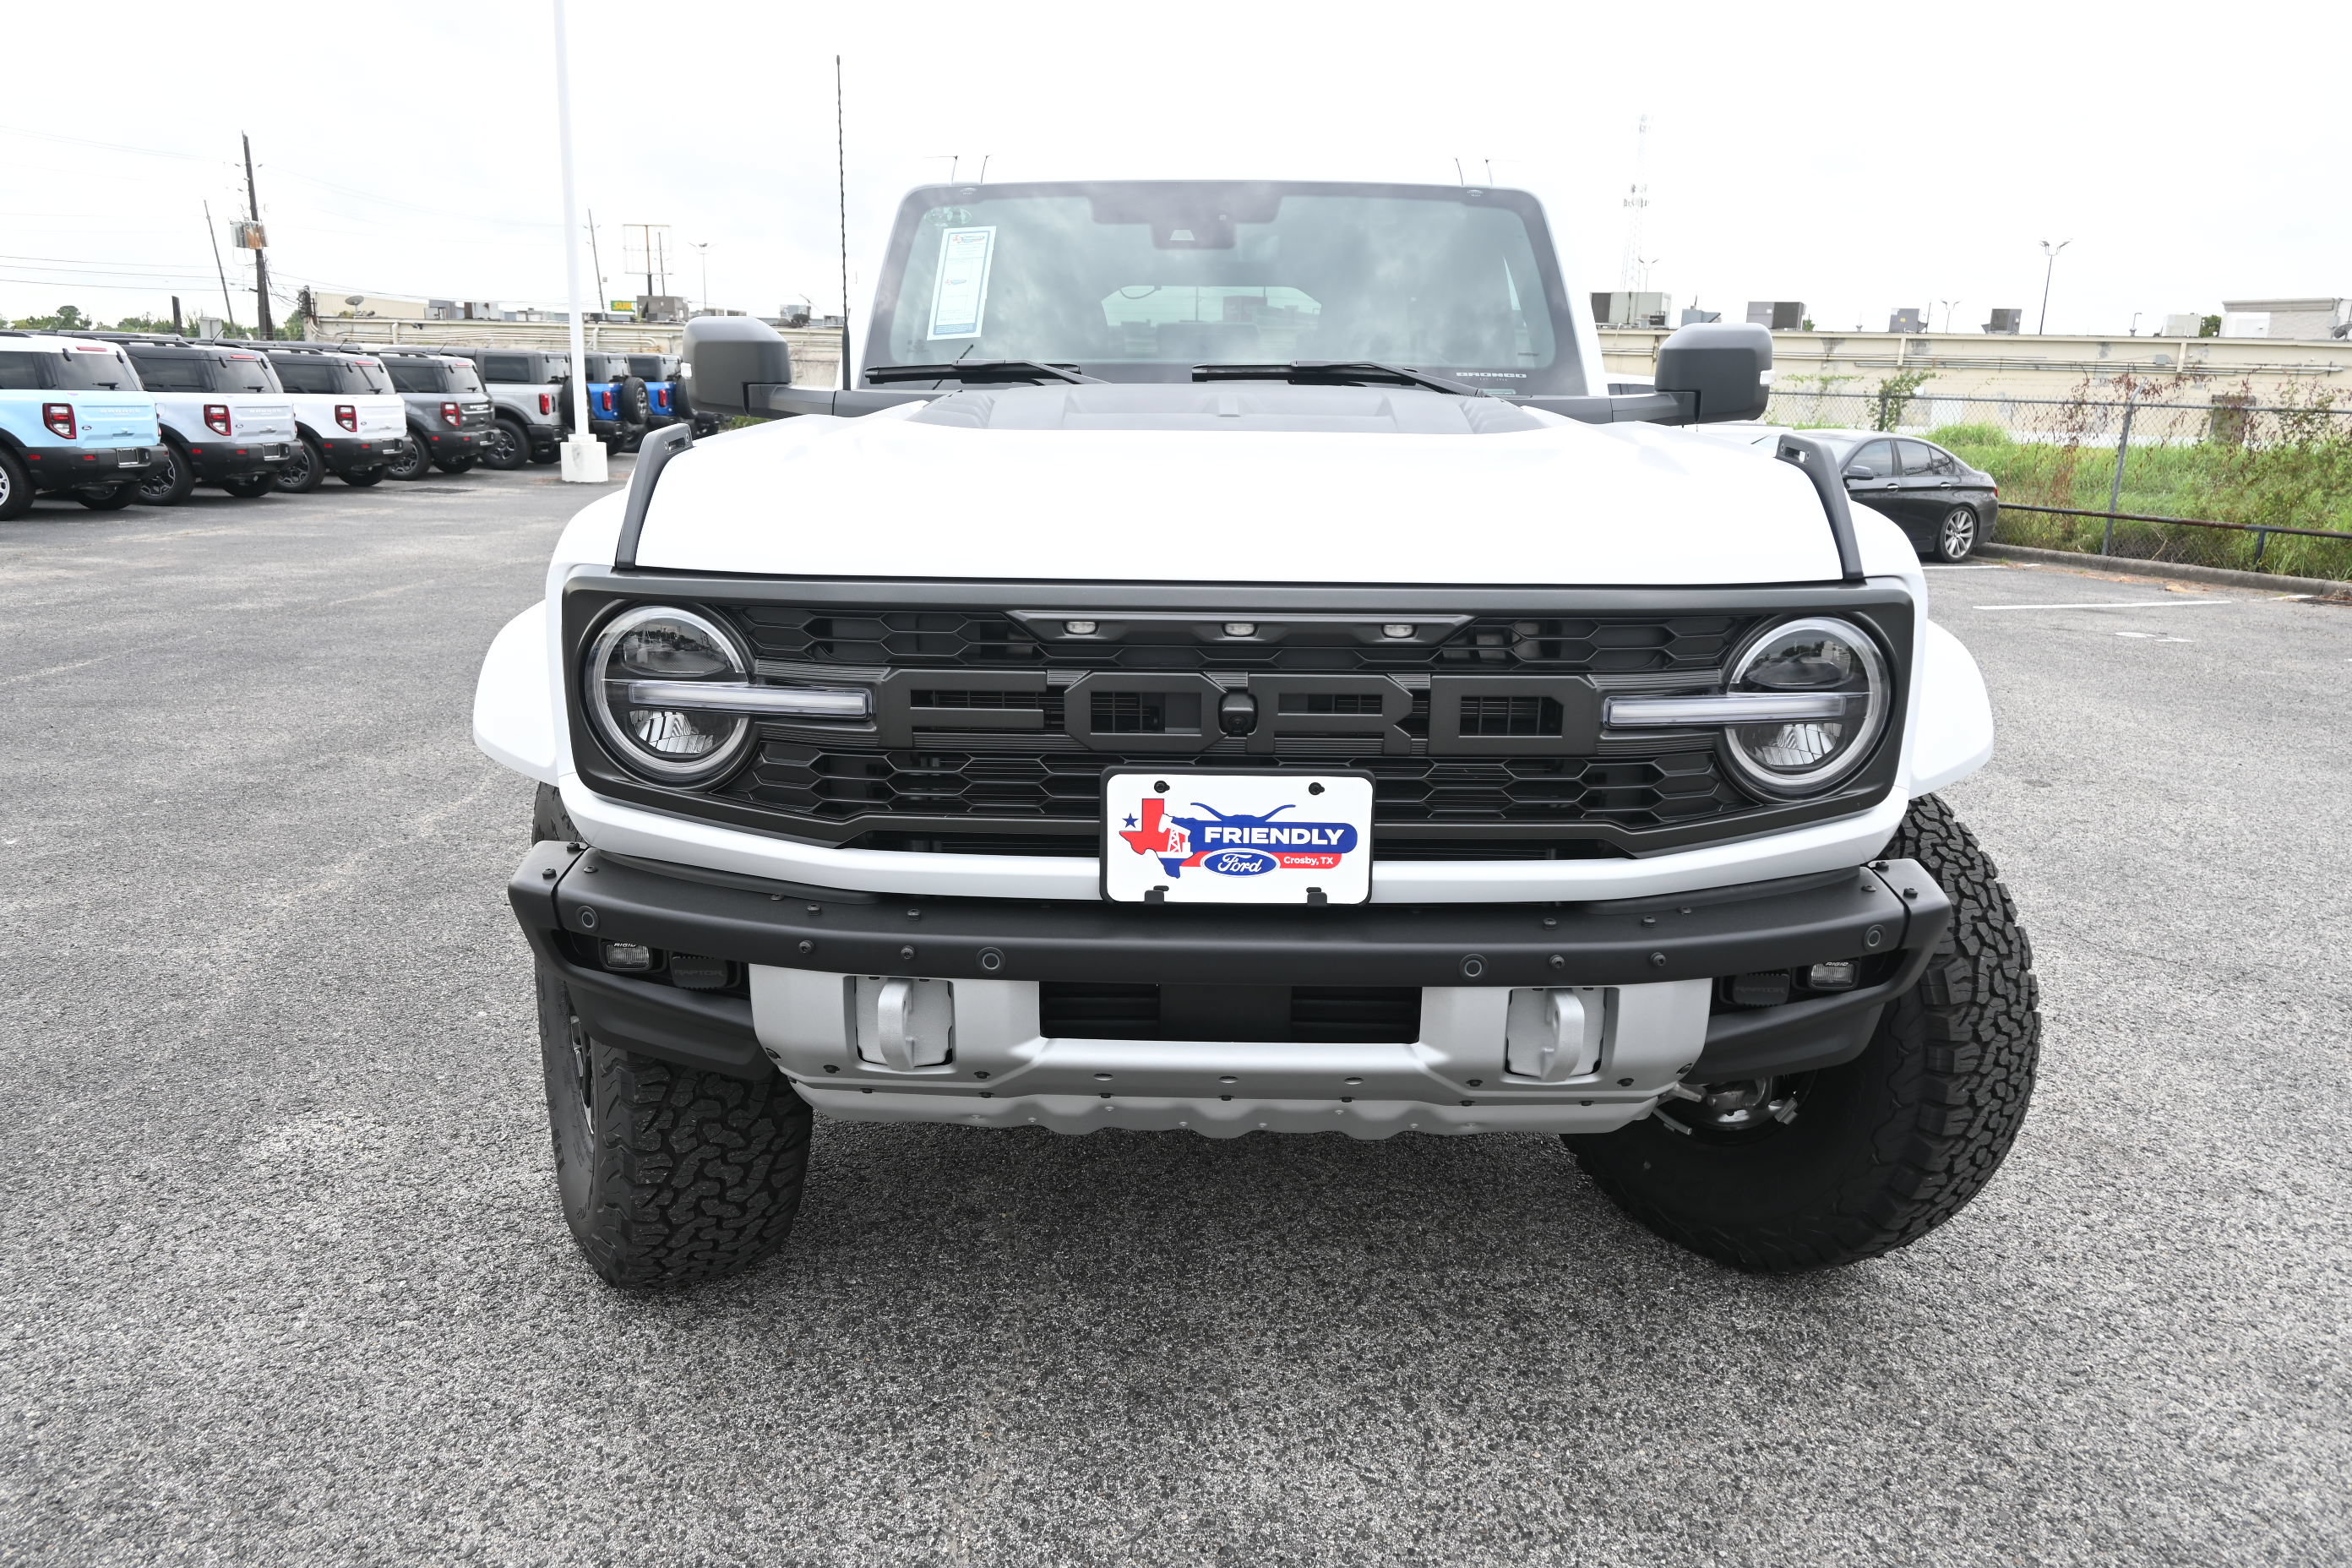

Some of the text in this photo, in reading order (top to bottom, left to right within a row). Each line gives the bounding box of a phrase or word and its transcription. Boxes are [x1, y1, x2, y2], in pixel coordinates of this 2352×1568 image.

[881, 669, 1597, 756] FORD
[1204, 826, 1345, 845] FRIENDLY
[1217, 852, 1264, 873] Ford
[1283, 856, 1334, 866] Crosby, TX
[674, 969, 724, 977] RAPTOR
